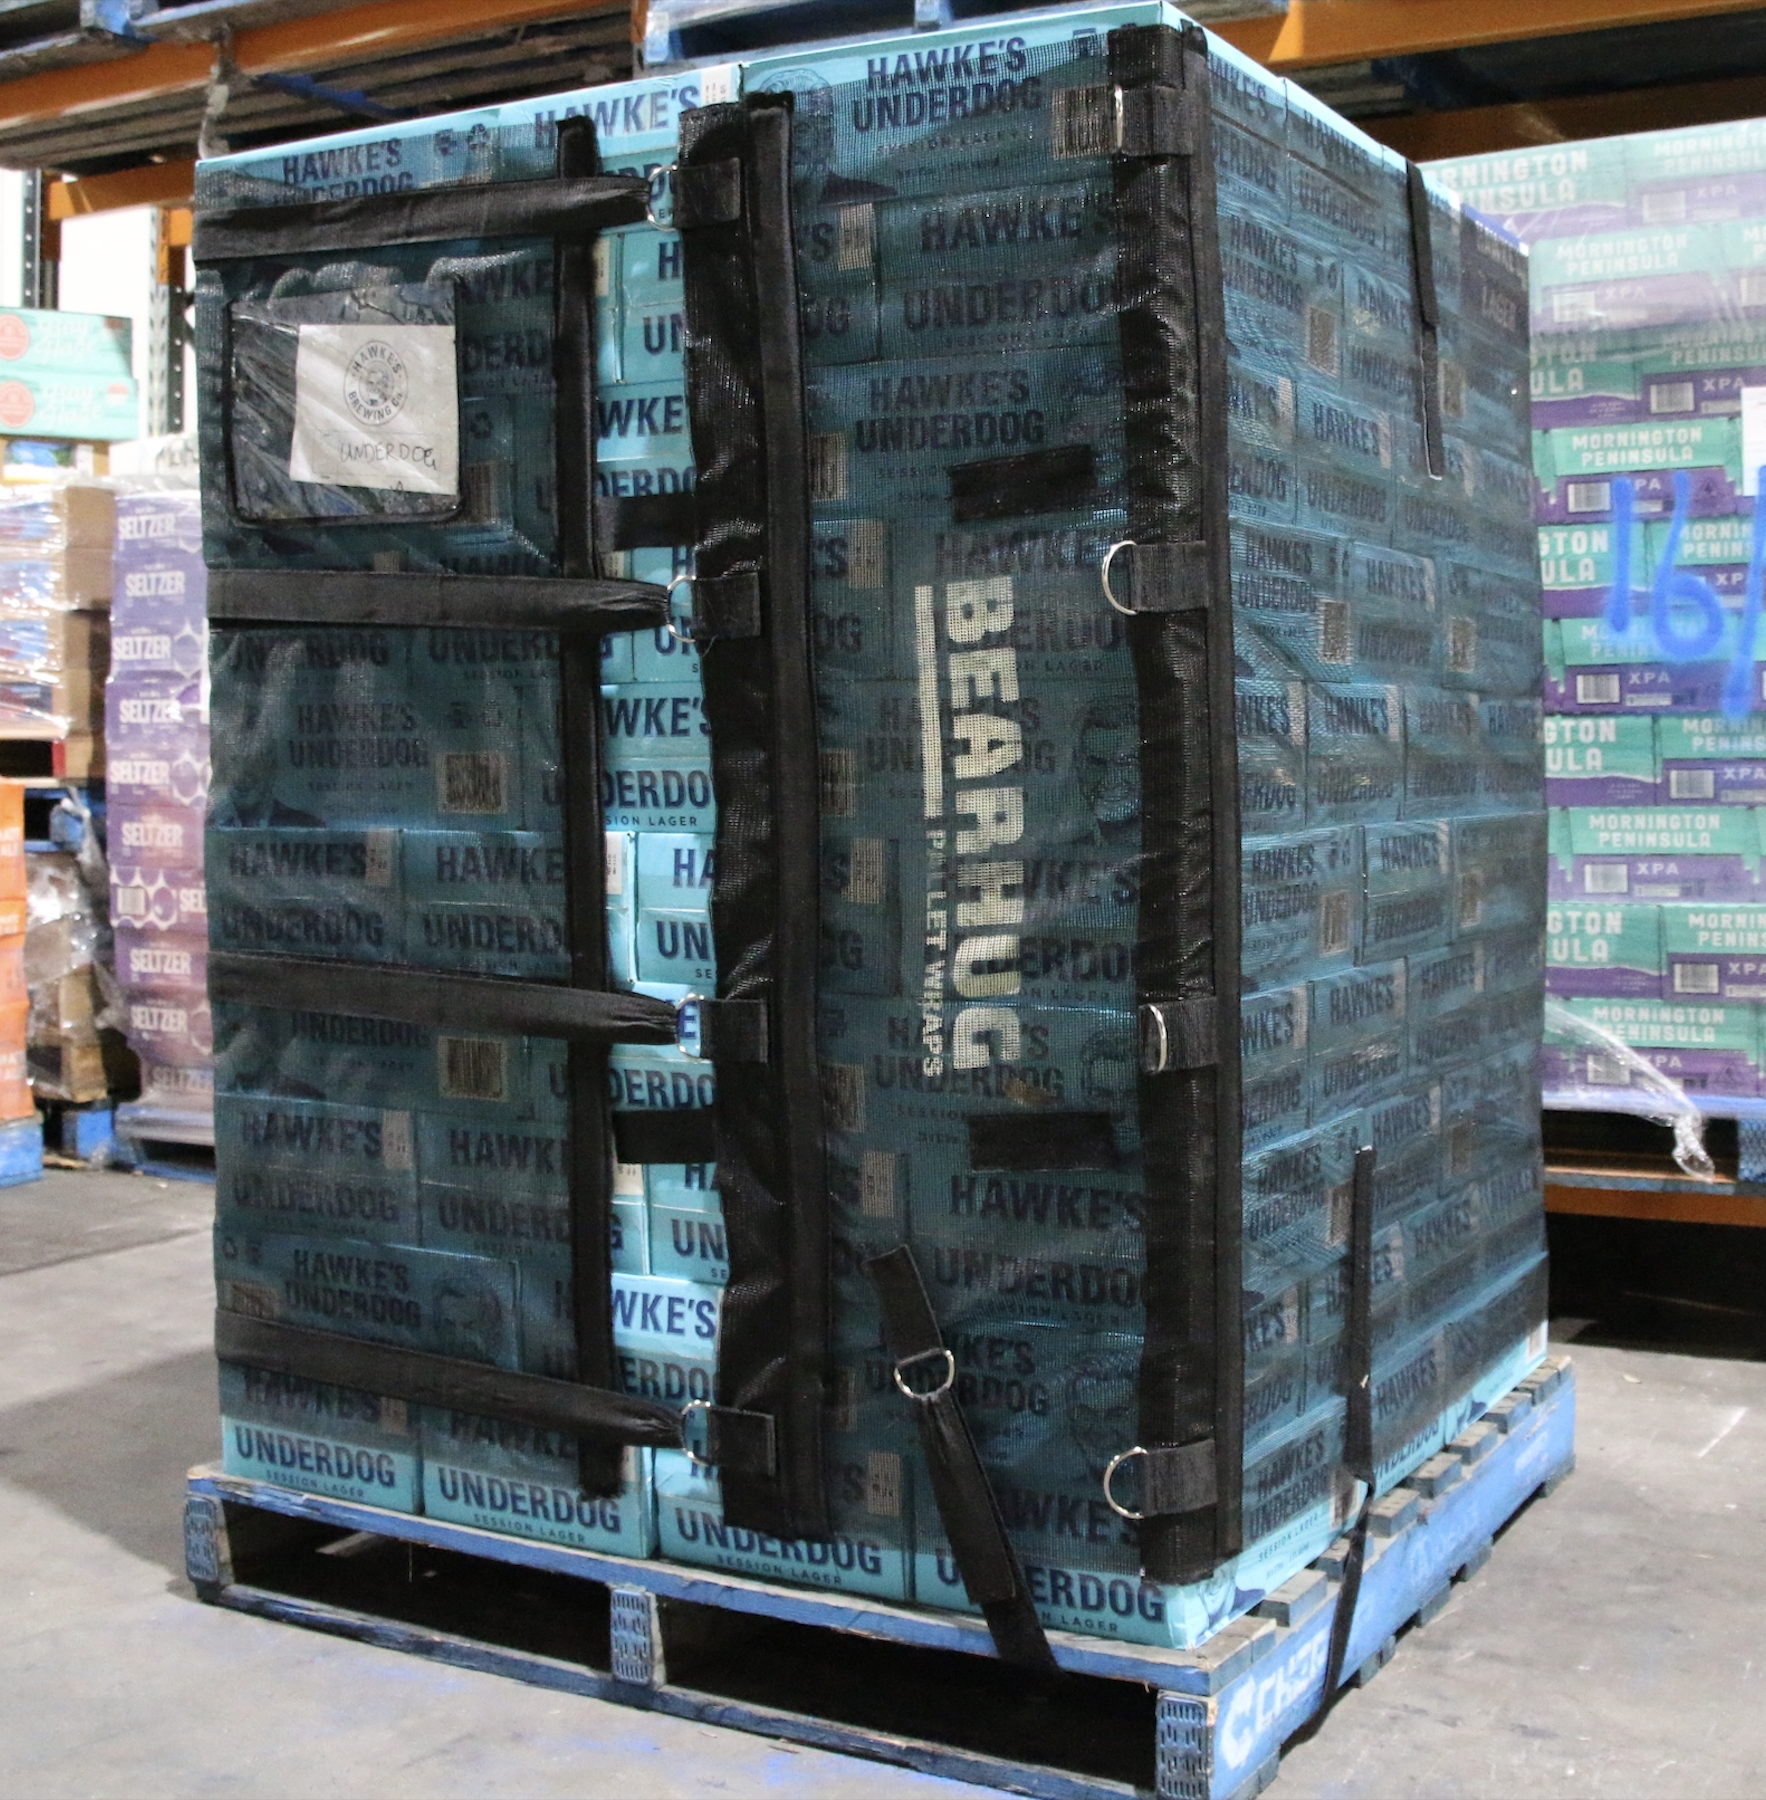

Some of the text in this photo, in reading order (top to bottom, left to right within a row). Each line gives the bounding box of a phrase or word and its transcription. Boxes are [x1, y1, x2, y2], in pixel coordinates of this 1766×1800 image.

[866, 37, 1028, 92] HAWKE'S
[852, 76, 1042, 132] UNDERDOG
[283, 138, 402, 186] HAWKE'S
[1697, 183, 1738, 199] XPA
[1556, 232, 1688, 261] MORNINGTON
[1567, 252, 1679, 277] PENINSULA
[1604, 284, 1647, 300] XPA
[868, 369, 1031, 412] HAWKE'S
[1703, 377, 1745, 392] XPA
[348, 391, 392, 421] BREWING
[855, 409, 1047, 452] UNDERDOG
[1572, 427, 1703, 451] MORNINGTON
[341, 442, 437, 471] UNDERDOG
[1582, 445, 1694, 468] PENINSULA
[118, 513, 176, 540] SELTZER
[125, 570, 186, 597] SELTZER
[111, 635, 172, 661] SELTZER
[1629, 671, 1671, 686] XPA
[110, 760, 170, 785] SELTZER
[122, 822, 184, 848] SELTZER
[650, 816, 698, 828] LAGER
[946, 575, 1024, 1070] BEARHUG
[1588, 813, 1721, 830] MORNINGTON
[1598, 832, 1711, 849] PENINSULA
[1637, 862, 1680, 876] XPA
[130, 948, 192, 975] SELTZER
[130, 1005, 189, 1032] SELTZER
[921, 954, 946, 1079] WRAPS
[1593, 1006, 1726, 1025] MORNINGTON
[234, 1424, 396, 1488] UNDERDOG
[267, 1468, 366, 1499] SESSION LAGER
[438, 1466, 621, 1533] UNDERDOG
[473, 1512, 586, 1545] SESSION LAGER
[675, 1506, 882, 1576] UNDERDOG
[1258, 1533, 1293, 1563] SESSION
[717, 1553, 843, 1587] SESSION LAGER
[936, 1548, 1166, 1624] UERDOG
[1060, 1614, 1118, 1634] LAGER
